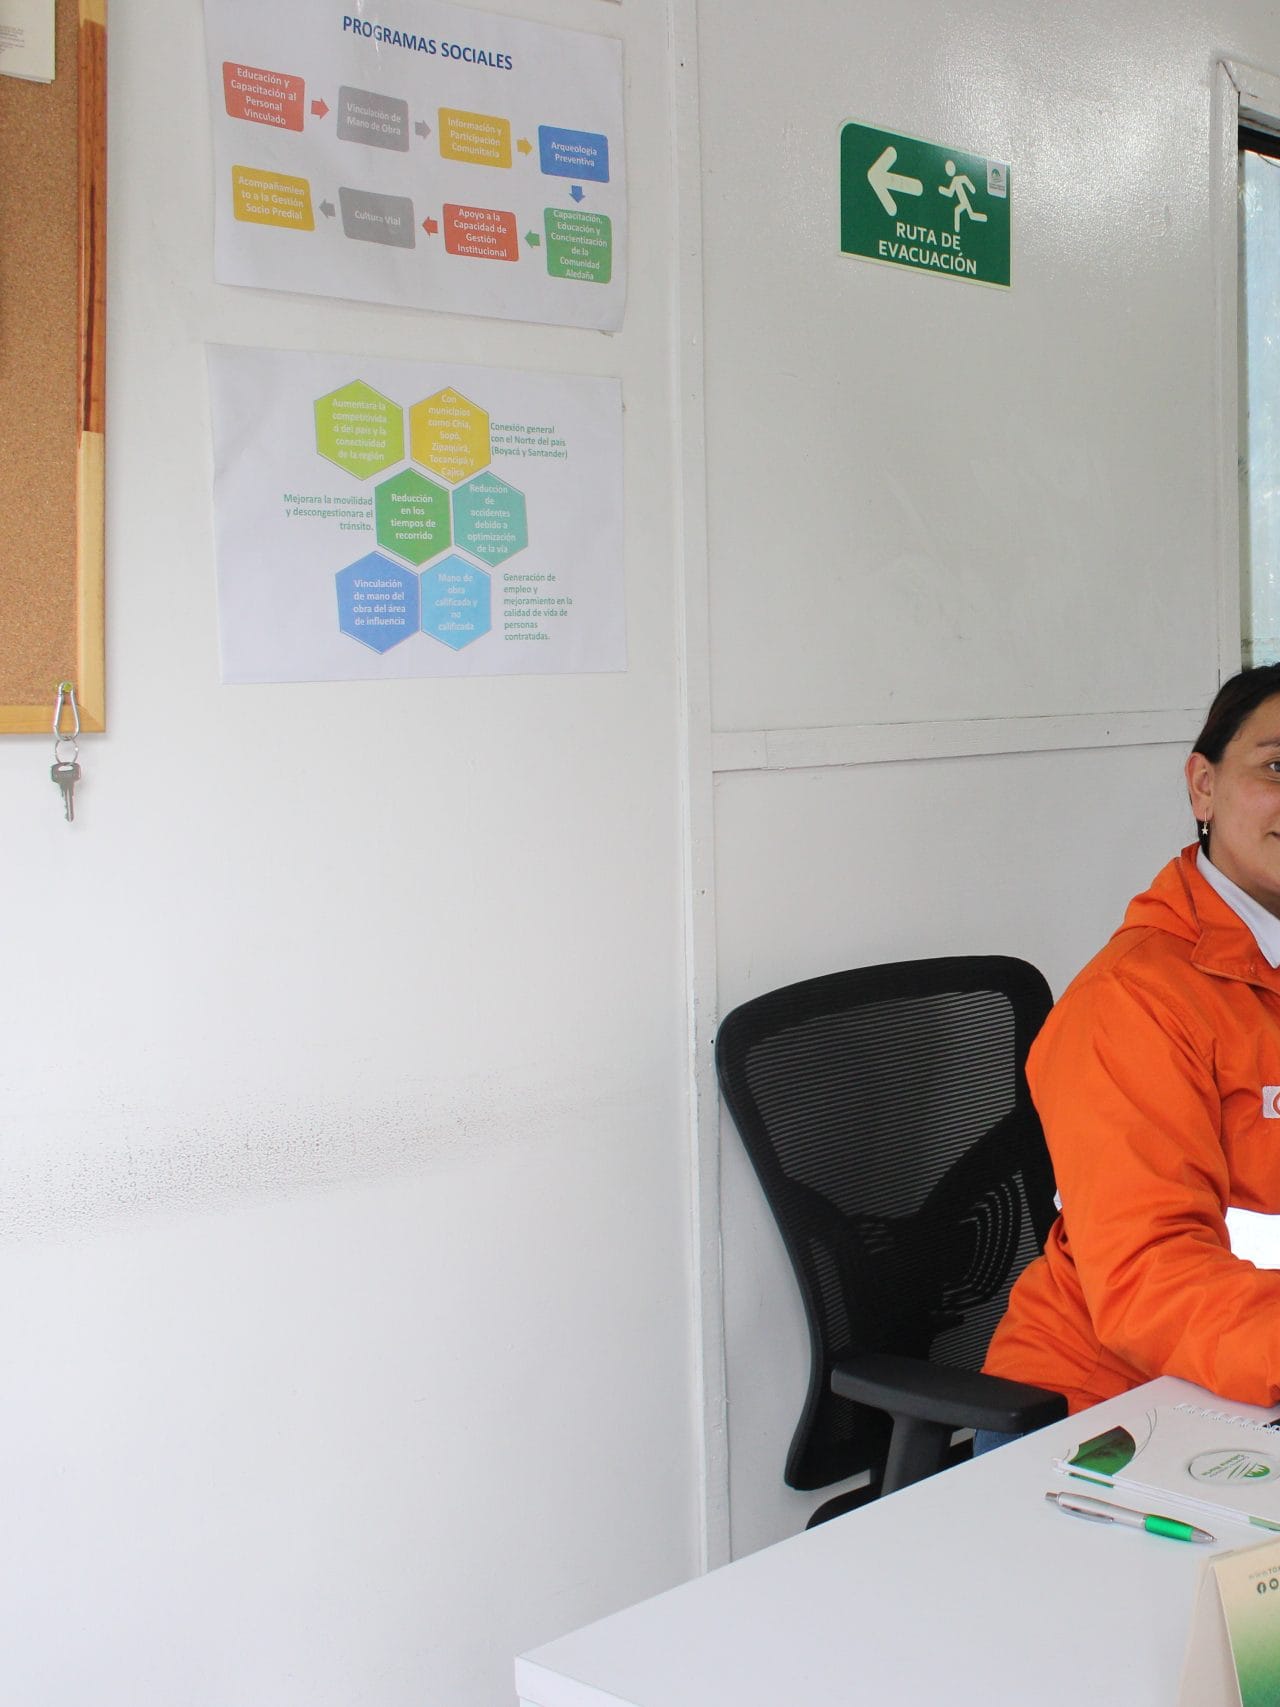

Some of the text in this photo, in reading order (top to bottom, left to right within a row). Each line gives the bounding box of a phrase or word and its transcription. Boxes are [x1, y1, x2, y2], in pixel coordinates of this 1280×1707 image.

[343, 16, 512, 70] PROGRAMAS SOCIALES
[237, 68, 281, 85] Educación
[231, 80, 296, 100] Capacitación al
[246, 96, 282, 112] Personal
[244, 108, 286, 125] Vinculado
[346, 102, 400, 122] Vinculación de
[347, 116, 400, 135] Mano de Obra
[448, 119, 495, 133] Información
[451, 131, 500, 146] Participación
[452, 143, 499, 158] Comunitaria
[555, 153, 594, 167] Preventiva
[242, 190, 251, 198] to
[261, 193, 269, 202] la
[272, 195, 304, 208] Gestión
[246, 203, 303, 219] Socio Predial
[459, 209, 484, 221] Apoyo
[493, 213, 500, 221] la
[355, 210, 400, 225] Cultura Vial
[454, 220, 506, 234] Capacidad de
[558, 222, 595, 233] Educación
[466, 233, 496, 244] Gestión
[551, 232, 607, 248] Concientización
[896, 222, 960, 250] RUTA DE
[458, 244, 506, 257] Institucional
[572, 247, 588, 256] de la
[560, 256, 599, 269] Comunidad
[879, 240, 976, 274] EVACUACIÓN
[566, 268, 593, 280] Aledaña
[442, 395, 456, 403] Con
[429, 407, 470, 416] municipios
[429, 419, 450, 427] como
[491, 423, 554, 434] Conexión general
[515, 437, 535, 445] Norte
[538, 438, 549, 446] del
[491, 447, 520, 456] (Boyacá
[529, 449, 567, 460] Santander)
[284, 494, 372, 506] Mejorara la movilidad
[392, 493, 433, 503] Reducción
[485, 496, 495, 505] de
[293, 507, 364, 518] descongestionara
[366, 509, 373, 518] el
[401, 506, 424, 515] en los
[470, 509, 510, 518] accidentes
[391, 519, 436, 529] tiempos de
[474, 520, 501, 529] debido
[396, 531, 432, 540] recorrido
[467, 532, 516, 543] optimización
[477, 544, 487, 552] de
[489, 545, 495, 553] la
[438, 574, 473, 582] Mano de
[504, 573, 545, 581] Generación
[354, 579, 402, 588] Vinculación
[504, 585, 531, 594] empleo
[354, 593, 365, 601] de
[392, 592, 404, 600] del
[504, 597, 555, 606] mejoramiento
[567, 597, 572, 605] la
[353, 605, 405, 613] obra del área
[504, 609, 530, 617] calidad
[533, 609, 541, 617] de
[544, 609, 557, 617] vida
[355, 617, 405, 626] de influencia
[504, 621, 538, 630] personas
